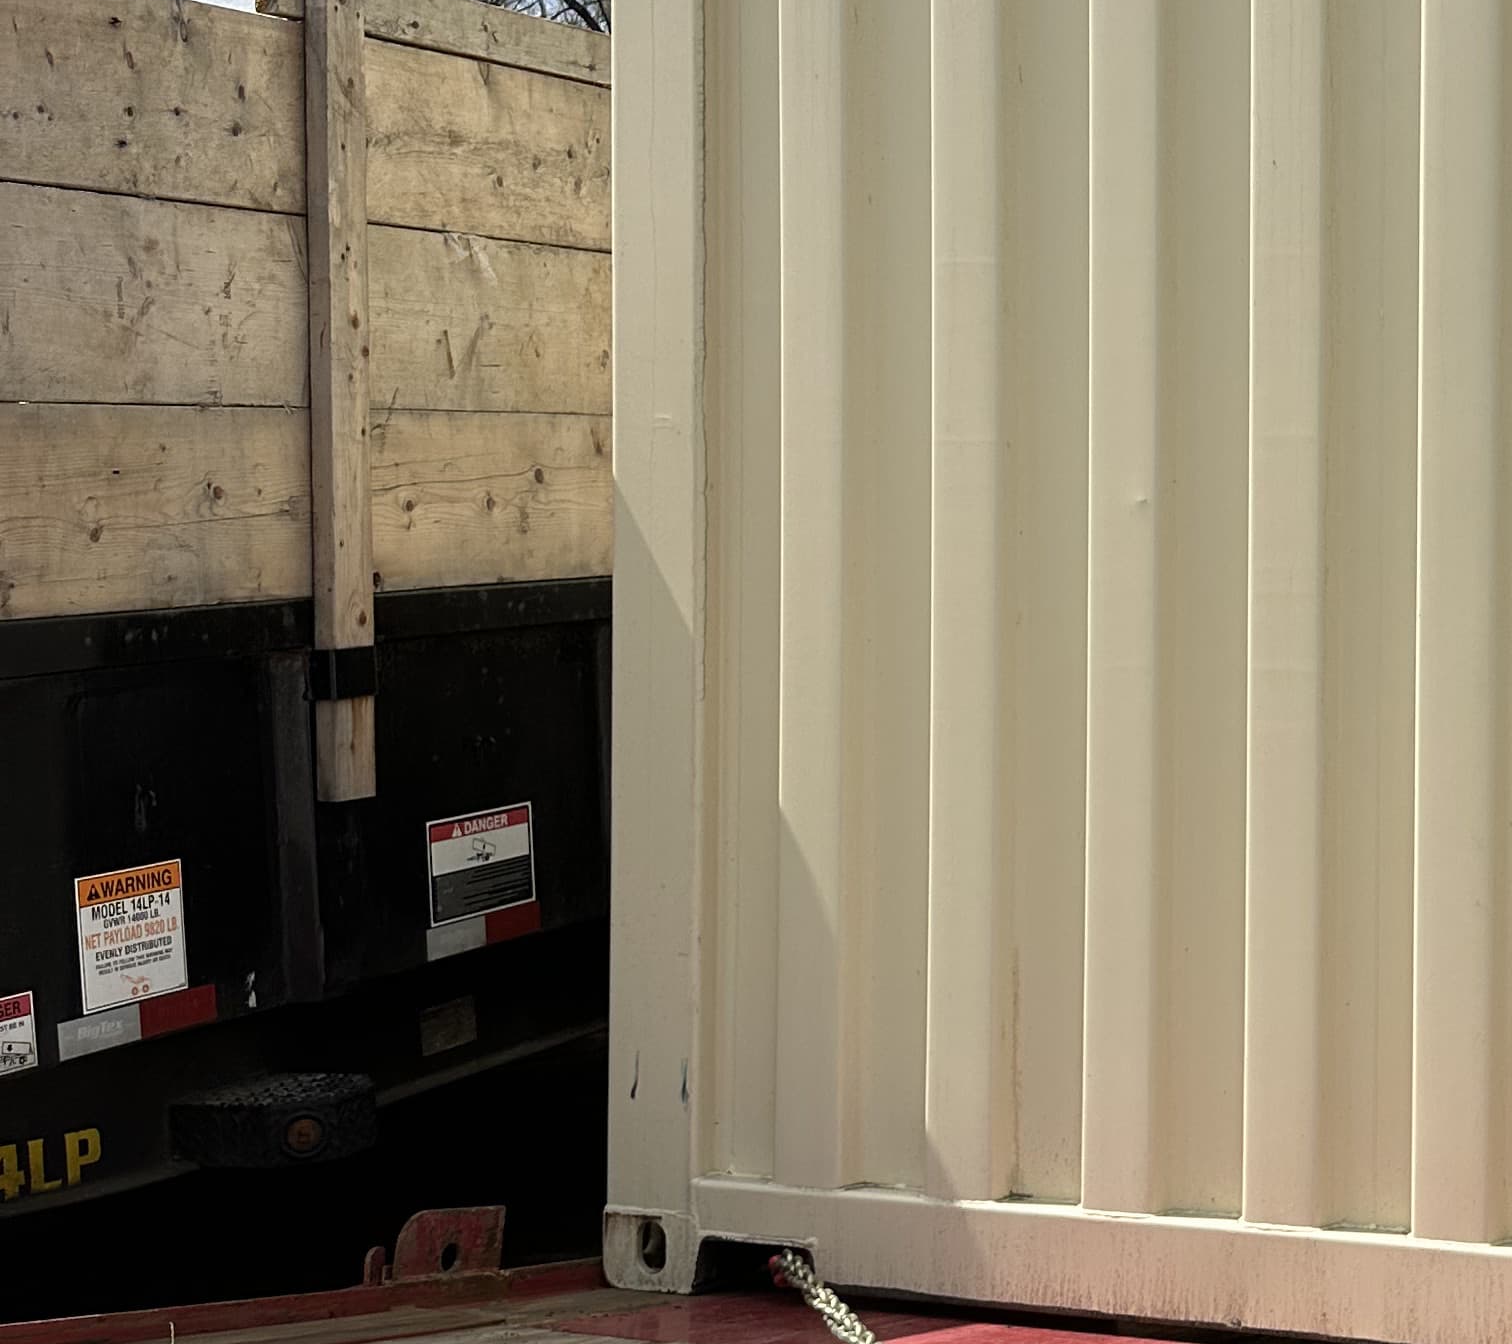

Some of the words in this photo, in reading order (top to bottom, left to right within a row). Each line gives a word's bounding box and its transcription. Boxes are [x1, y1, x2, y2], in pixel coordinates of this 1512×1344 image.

[464, 813, 508, 836] DANGER
[100, 868, 172, 896] WARNING
[92, 900, 128, 920] MODEL
[131, 892, 171, 913] 14LP-14
[85, 934, 101, 951] NET
[104, 925, 143, 946] PAYLOAD
[96, 945, 122, 962] EVENLY
